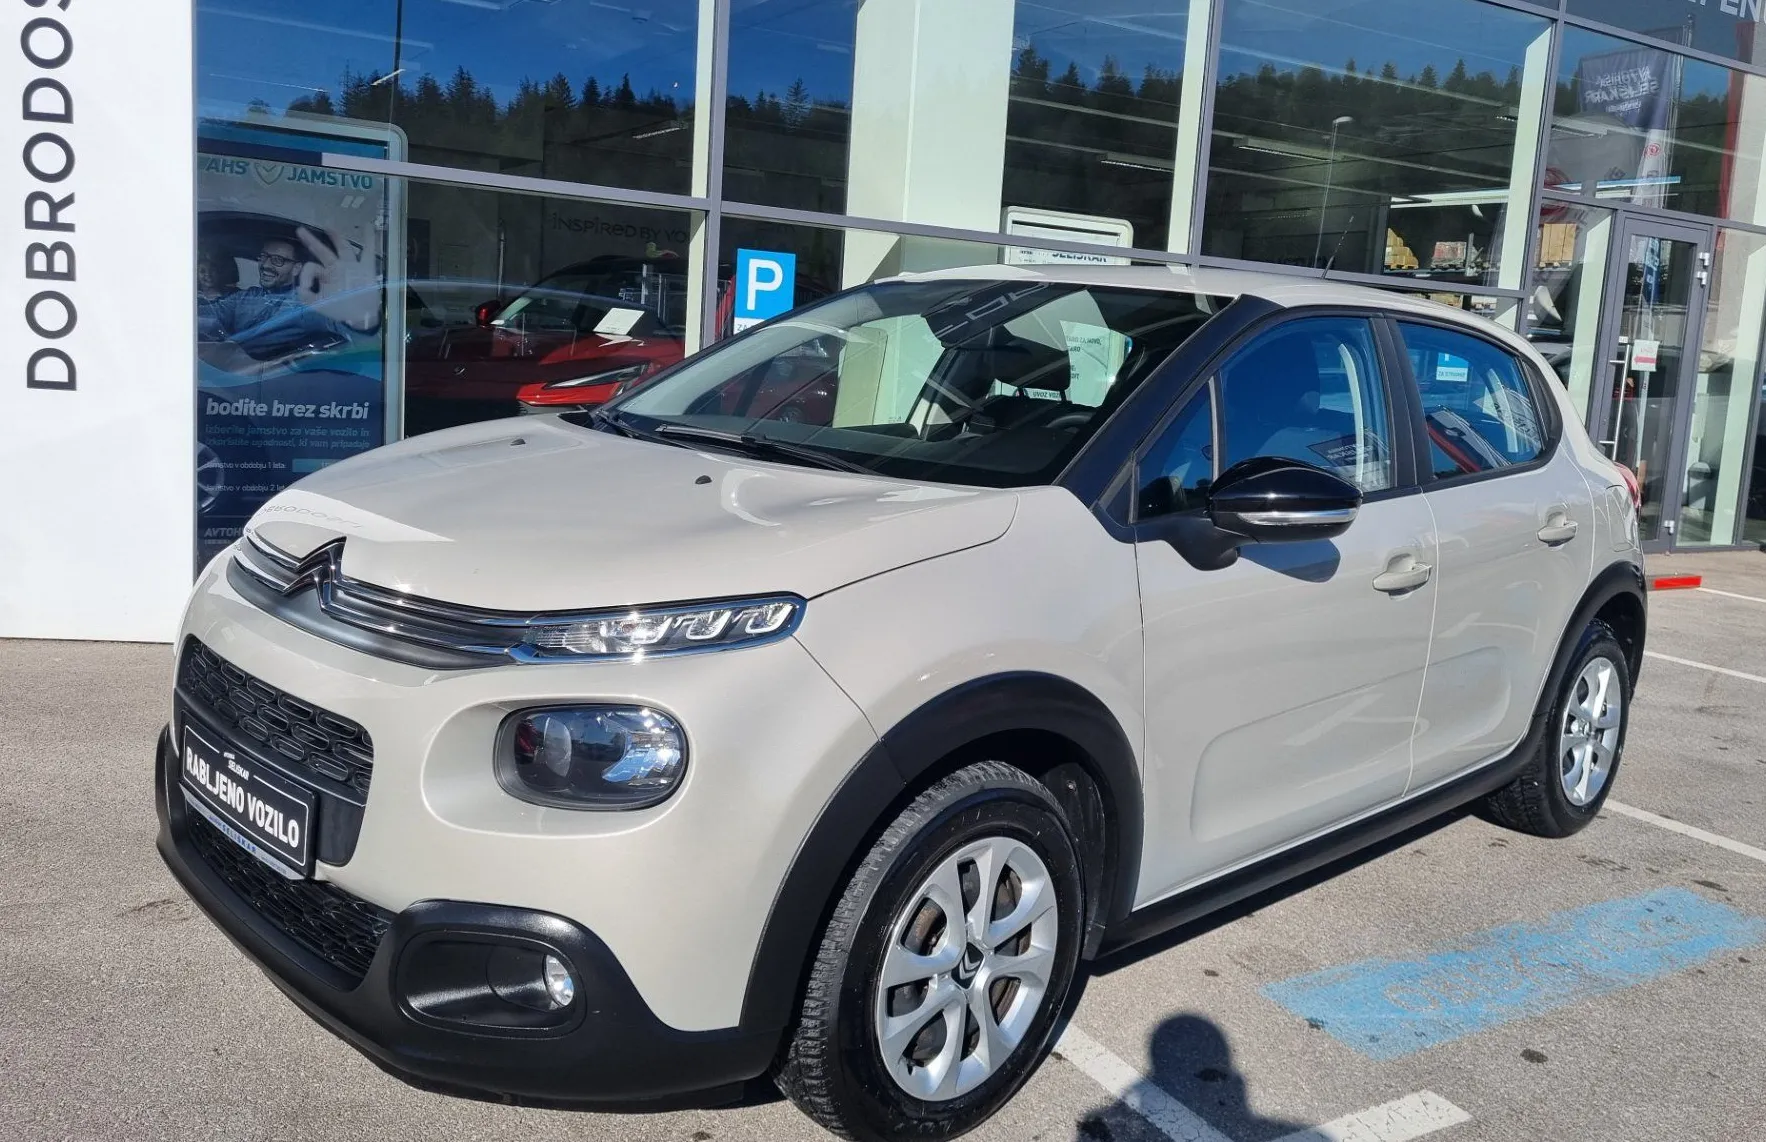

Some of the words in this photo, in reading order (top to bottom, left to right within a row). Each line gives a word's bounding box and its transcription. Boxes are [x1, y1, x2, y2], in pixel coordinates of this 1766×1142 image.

[287, 166, 373, 189] JAMSTVO
[640, 226, 661, 240] BY
[663, 229, 688, 244] YO
[747, 258, 783, 311] P
[206, 398, 268, 416] bodite
[272, 400, 316, 418] brez
[319, 402, 370, 419] skrbi
[246, 425, 287, 436] jamstvo
[290, 428, 301, 436] za
[304, 426, 327, 436] vaše
[360, 427, 369, 437] in
[186, 747, 245, 813] RABLJENO
[247, 792, 300, 848] VOZILO
